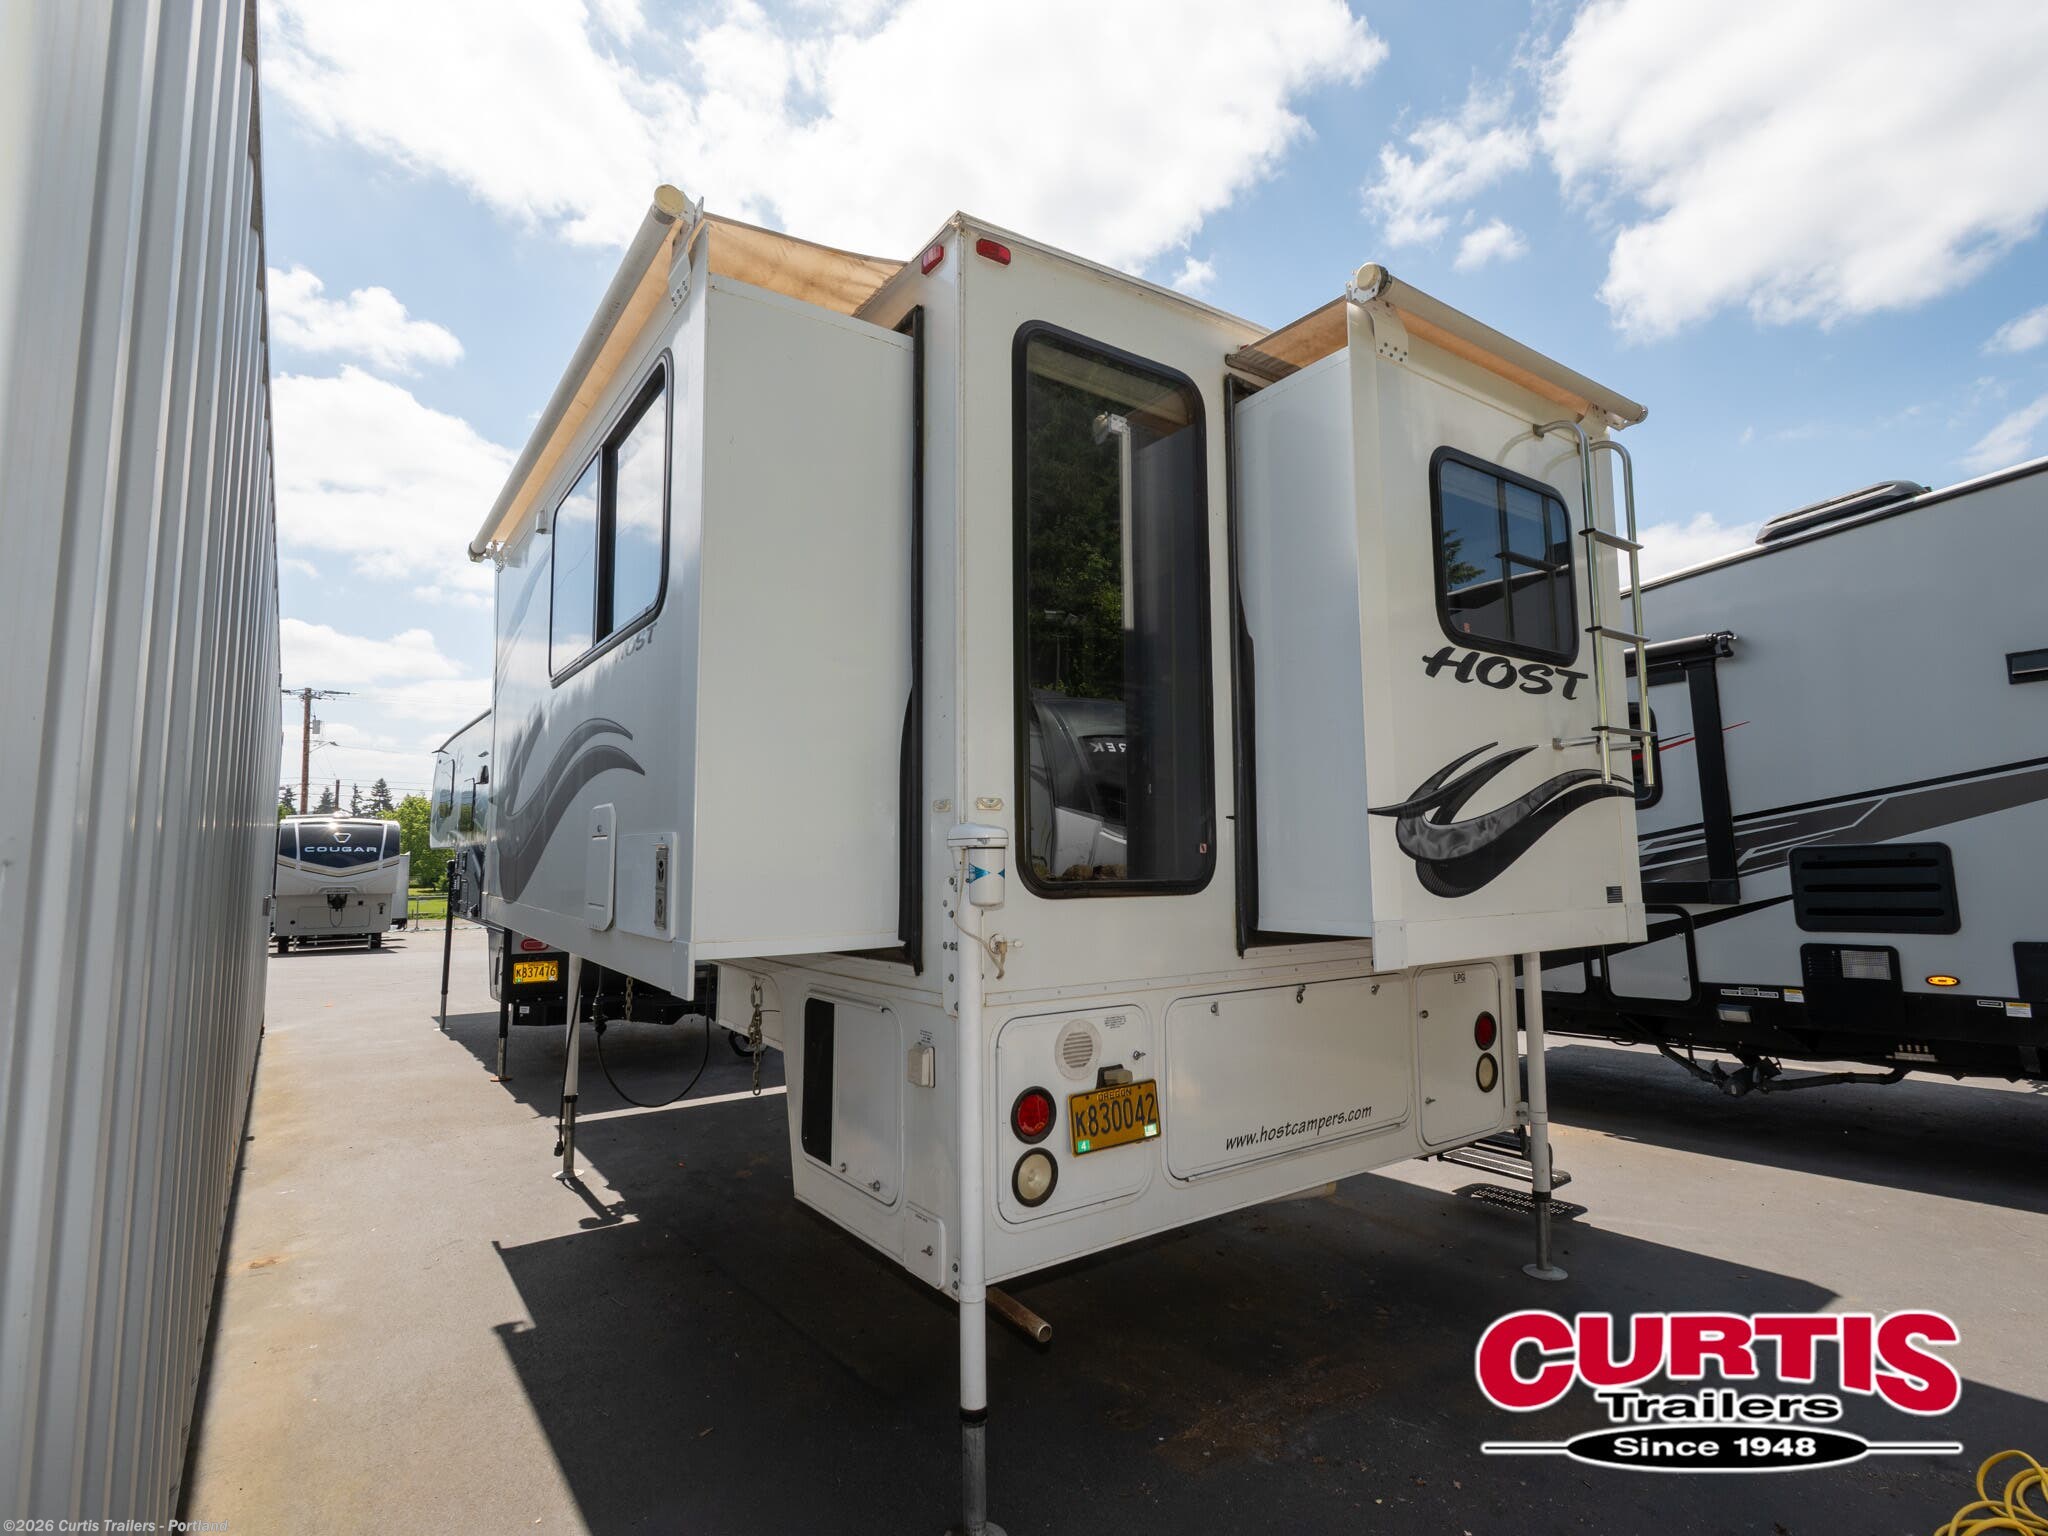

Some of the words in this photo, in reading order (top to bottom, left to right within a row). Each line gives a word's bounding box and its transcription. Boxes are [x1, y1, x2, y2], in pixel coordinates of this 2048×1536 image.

[1422, 645, 1589, 700] HOST
[1075, 1093, 1156, 1137] K830042
[1097, 1087, 1132, 1101] OREGON
[1225, 1106, 1372, 1150] www.hostcampers.com
